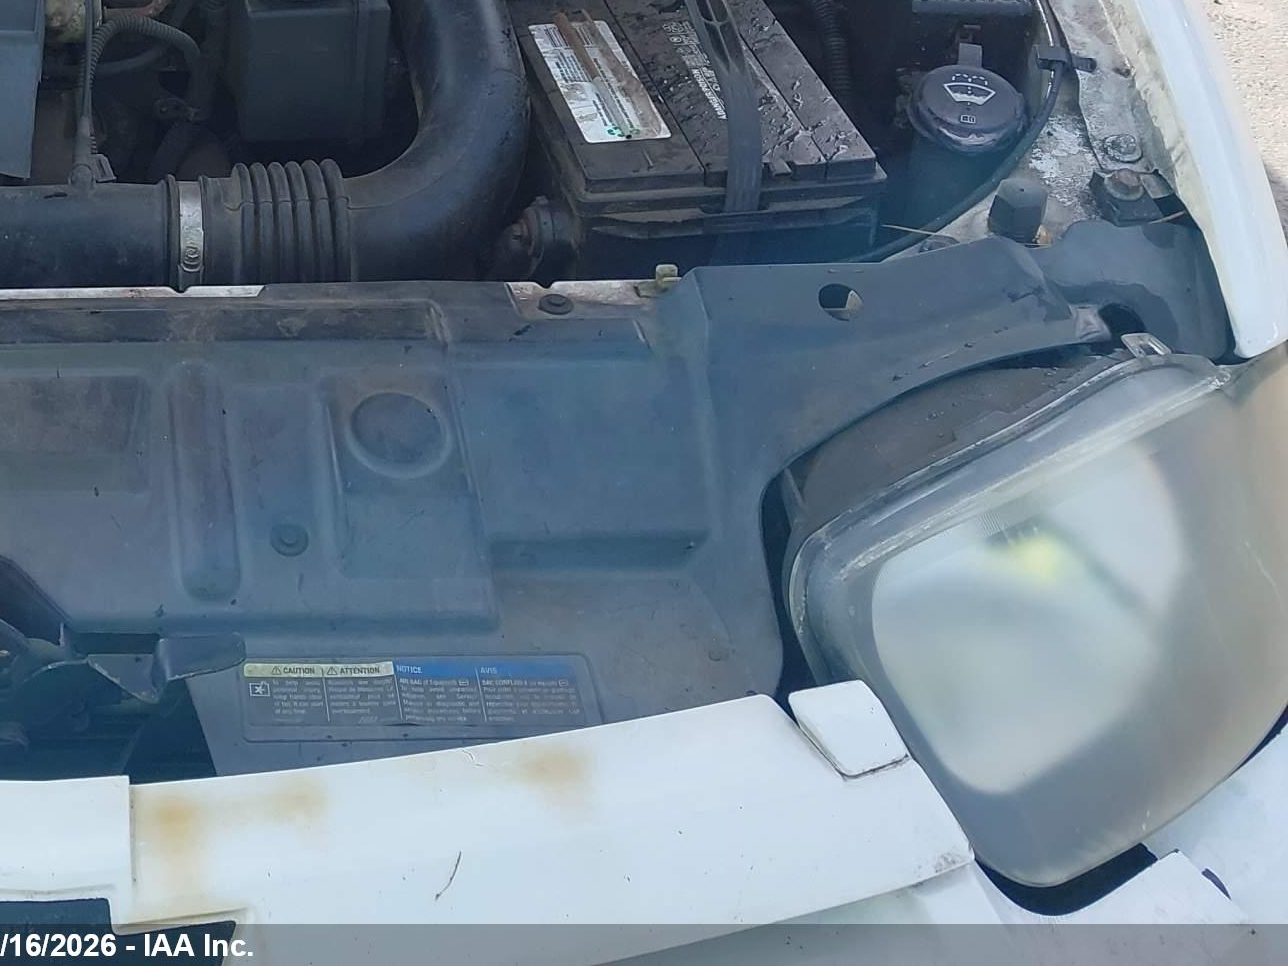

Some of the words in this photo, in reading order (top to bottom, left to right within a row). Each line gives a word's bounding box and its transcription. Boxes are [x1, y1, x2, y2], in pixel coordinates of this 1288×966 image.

[283, 666, 315, 675] CAUTION
[339, 666, 380, 674] ATTENTION
[396, 665, 422, 674] NOTICE
